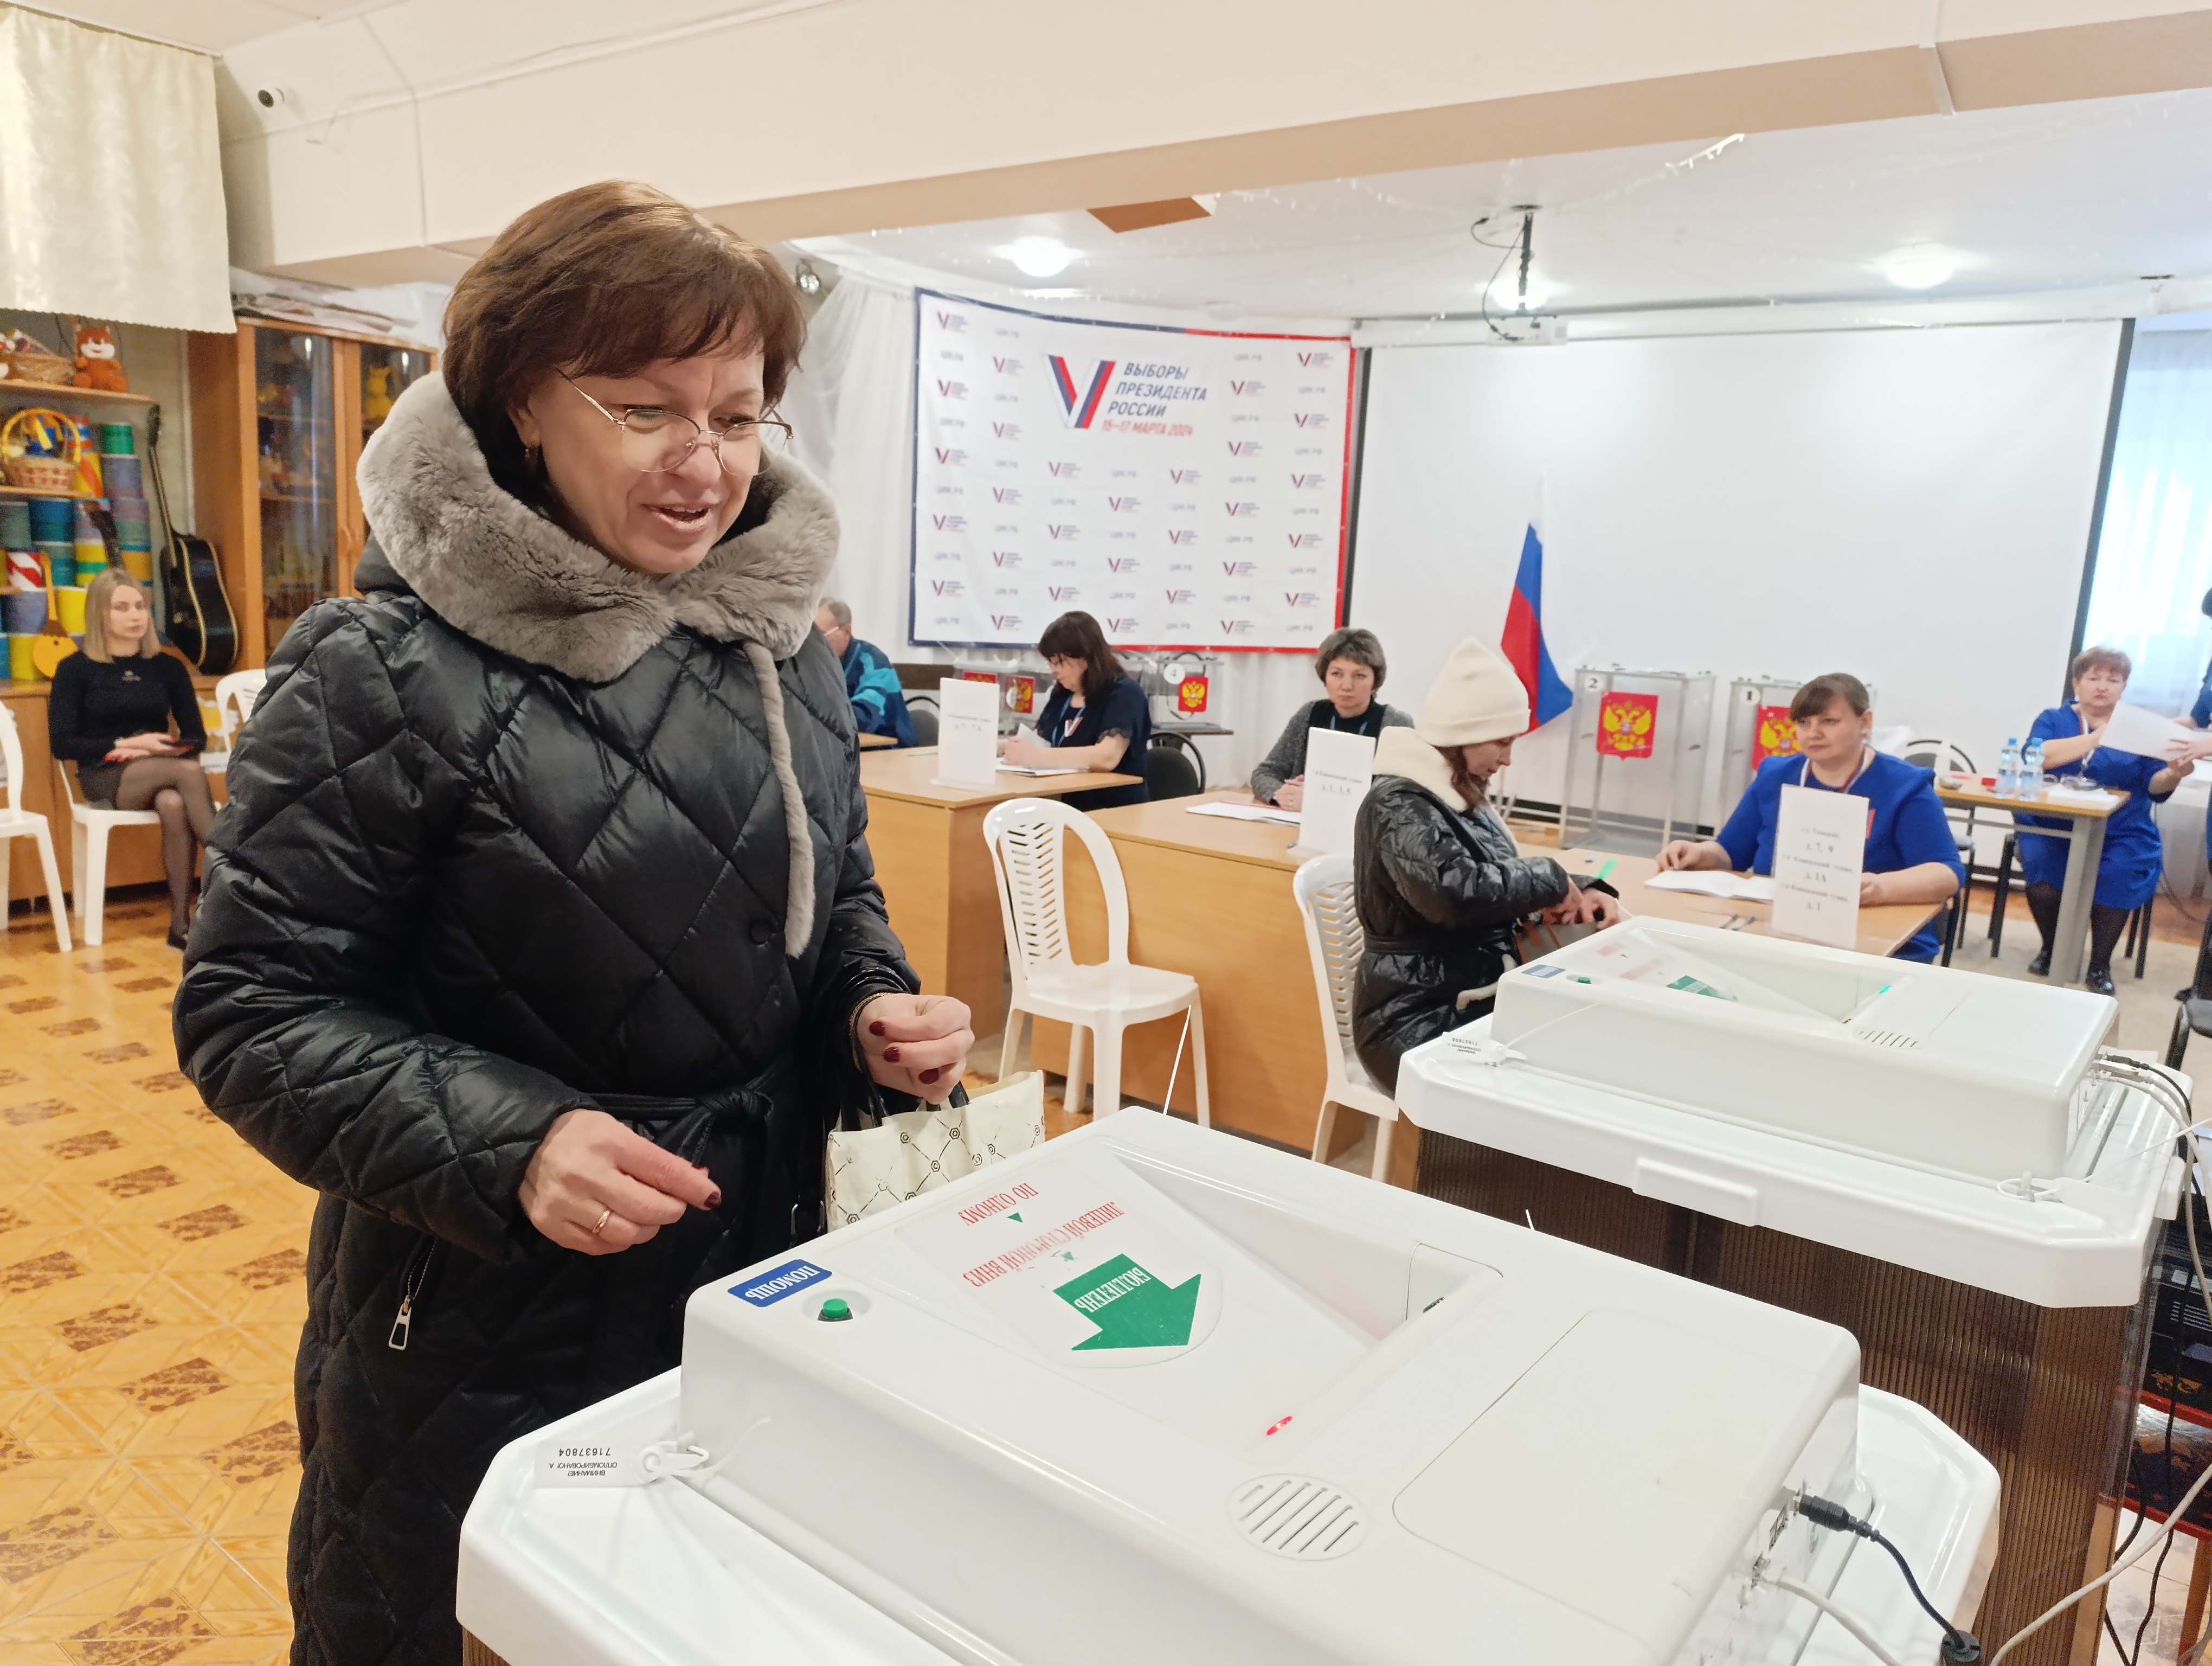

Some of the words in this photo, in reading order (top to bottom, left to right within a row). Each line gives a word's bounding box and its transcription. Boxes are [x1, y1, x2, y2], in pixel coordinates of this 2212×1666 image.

[1124, 362, 1189, 380] ВЫБОРЫ
[1115, 382, 1207, 400] ПРЕЗИДЕНТА
[1108, 401, 1167, 417] РОССИИ
[1132, 421, 1167, 435] МАРТА
[1168, 423, 1194, 436] 2024
[1589, 677, 1598, 689] 2
[1746, 690, 1752, 701] 1
[1012, 1183, 1039, 1199] ПО
[958, 1193, 1017, 1226] ОДНОМУ
[1062, 1201, 1125, 1239] ЛИЦЕВОЙ
[963, 1260, 1008, 1286] ВНИЗ
[744, 1265, 820, 1300] ПОМОЩЬ
[1074, 1267, 1151, 1312] БЮЛЛЕТЕНЬ
[558, 1447, 611, 1457] 71637804
